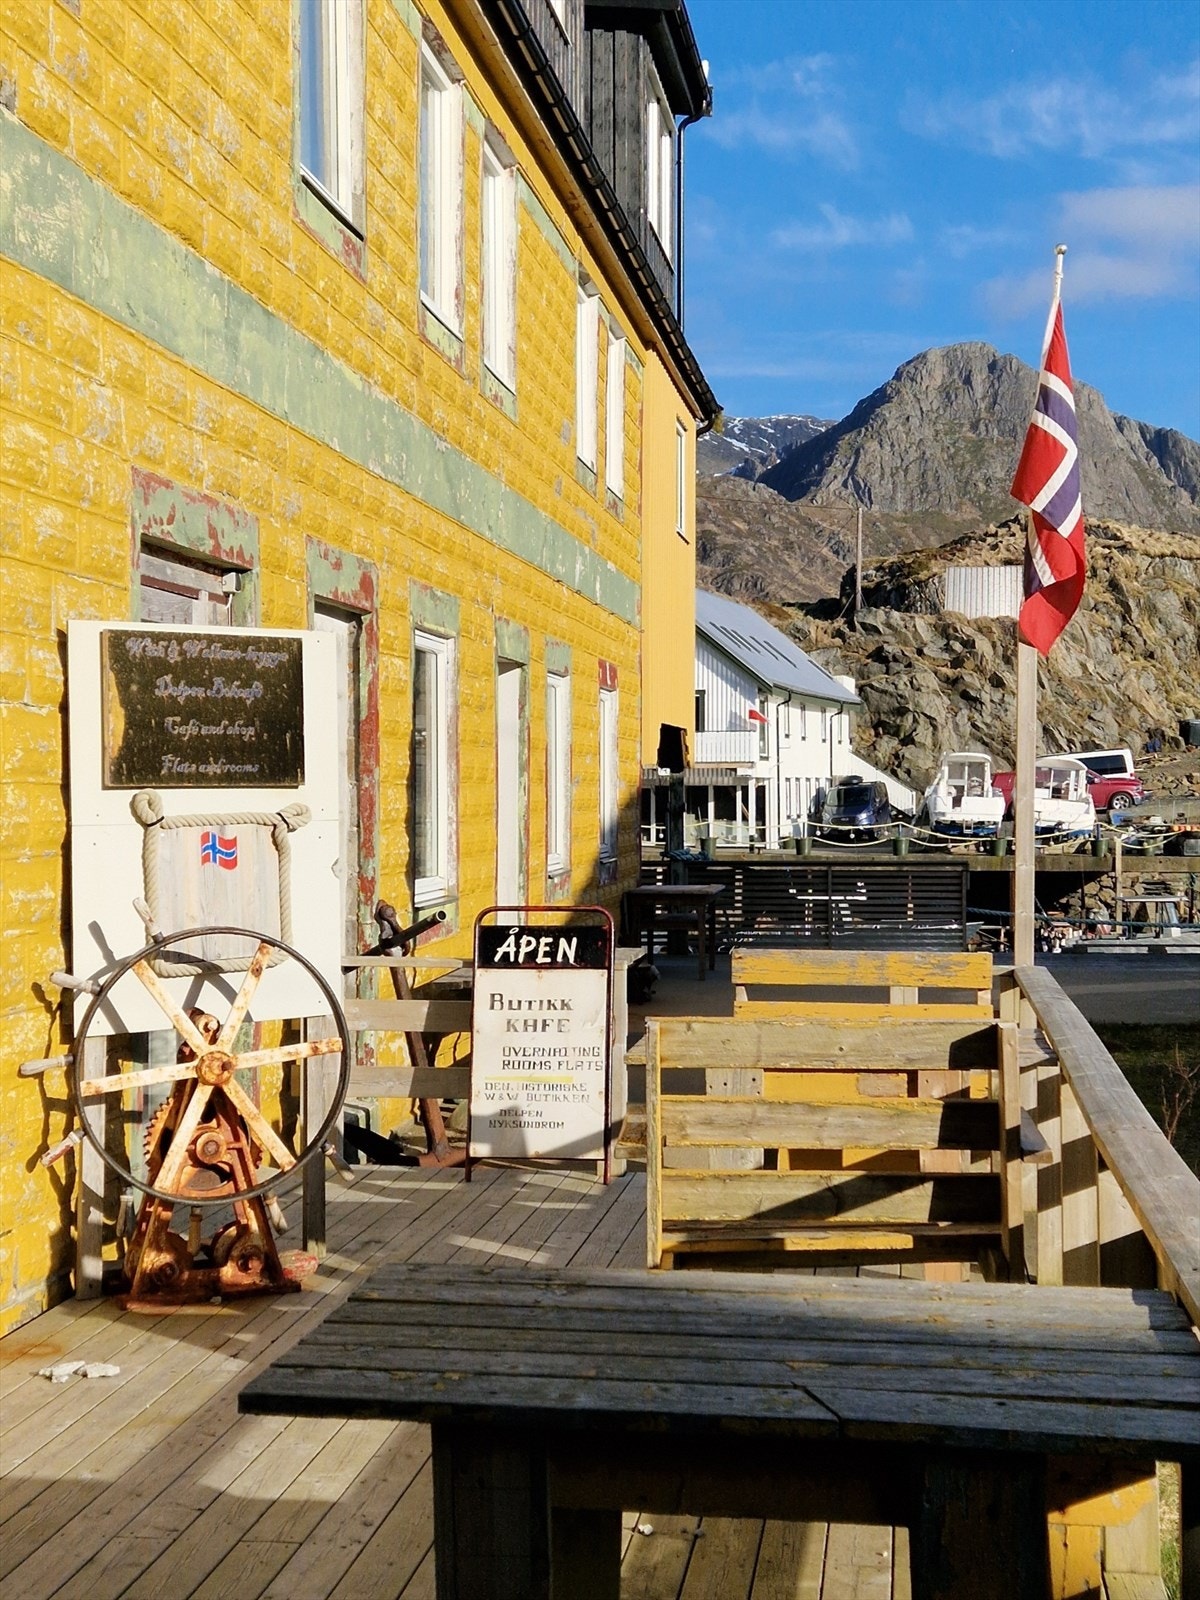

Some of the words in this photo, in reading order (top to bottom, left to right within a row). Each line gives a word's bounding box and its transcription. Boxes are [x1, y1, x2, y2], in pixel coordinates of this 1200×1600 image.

[200, 720, 228, 735] and
[160, 754, 197, 775] Flats
[198, 758, 225, 774] and
[493, 927, 580, 967] ÅPEN
[506, 1018, 571, 1033] KAFE
[557, 1060, 604, 1071] FLATS
[526, 1093, 591, 1103] BUTIKKEN
[499, 1109, 544, 1118] DELPEN
